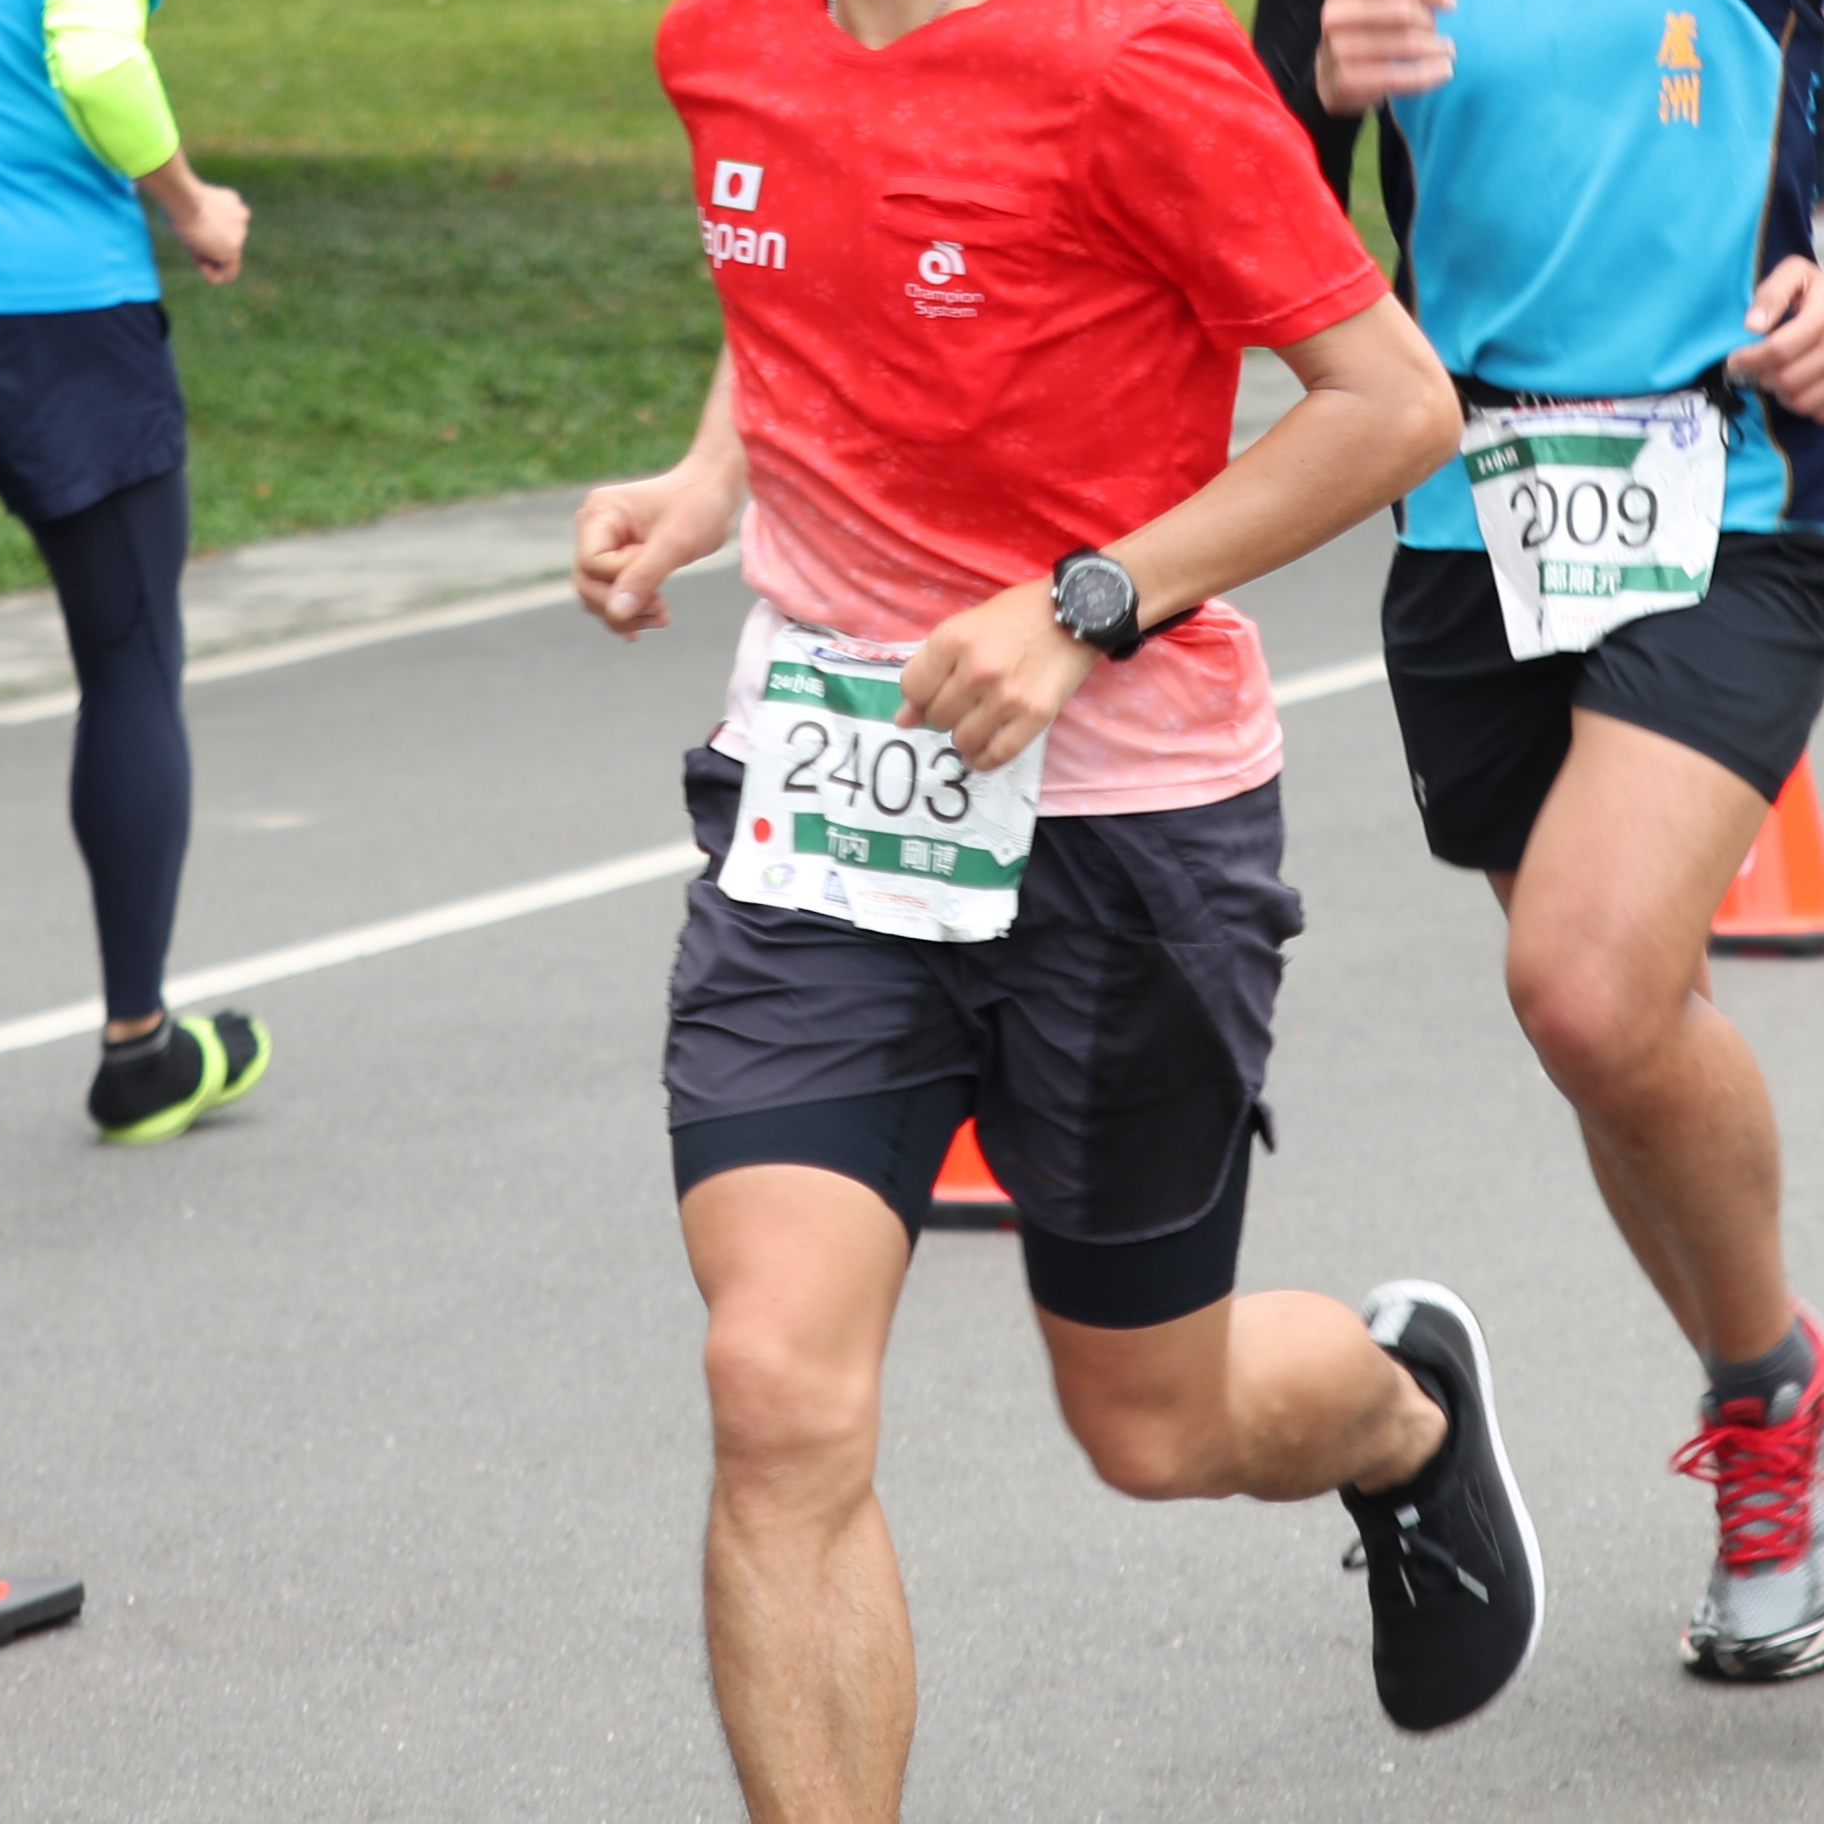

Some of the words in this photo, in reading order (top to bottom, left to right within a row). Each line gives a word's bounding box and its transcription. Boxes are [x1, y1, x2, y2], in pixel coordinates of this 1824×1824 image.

[905, 283, 985, 304] Champion
[914, 300, 978, 319] System
[782, 721, 970, 823] 2403
